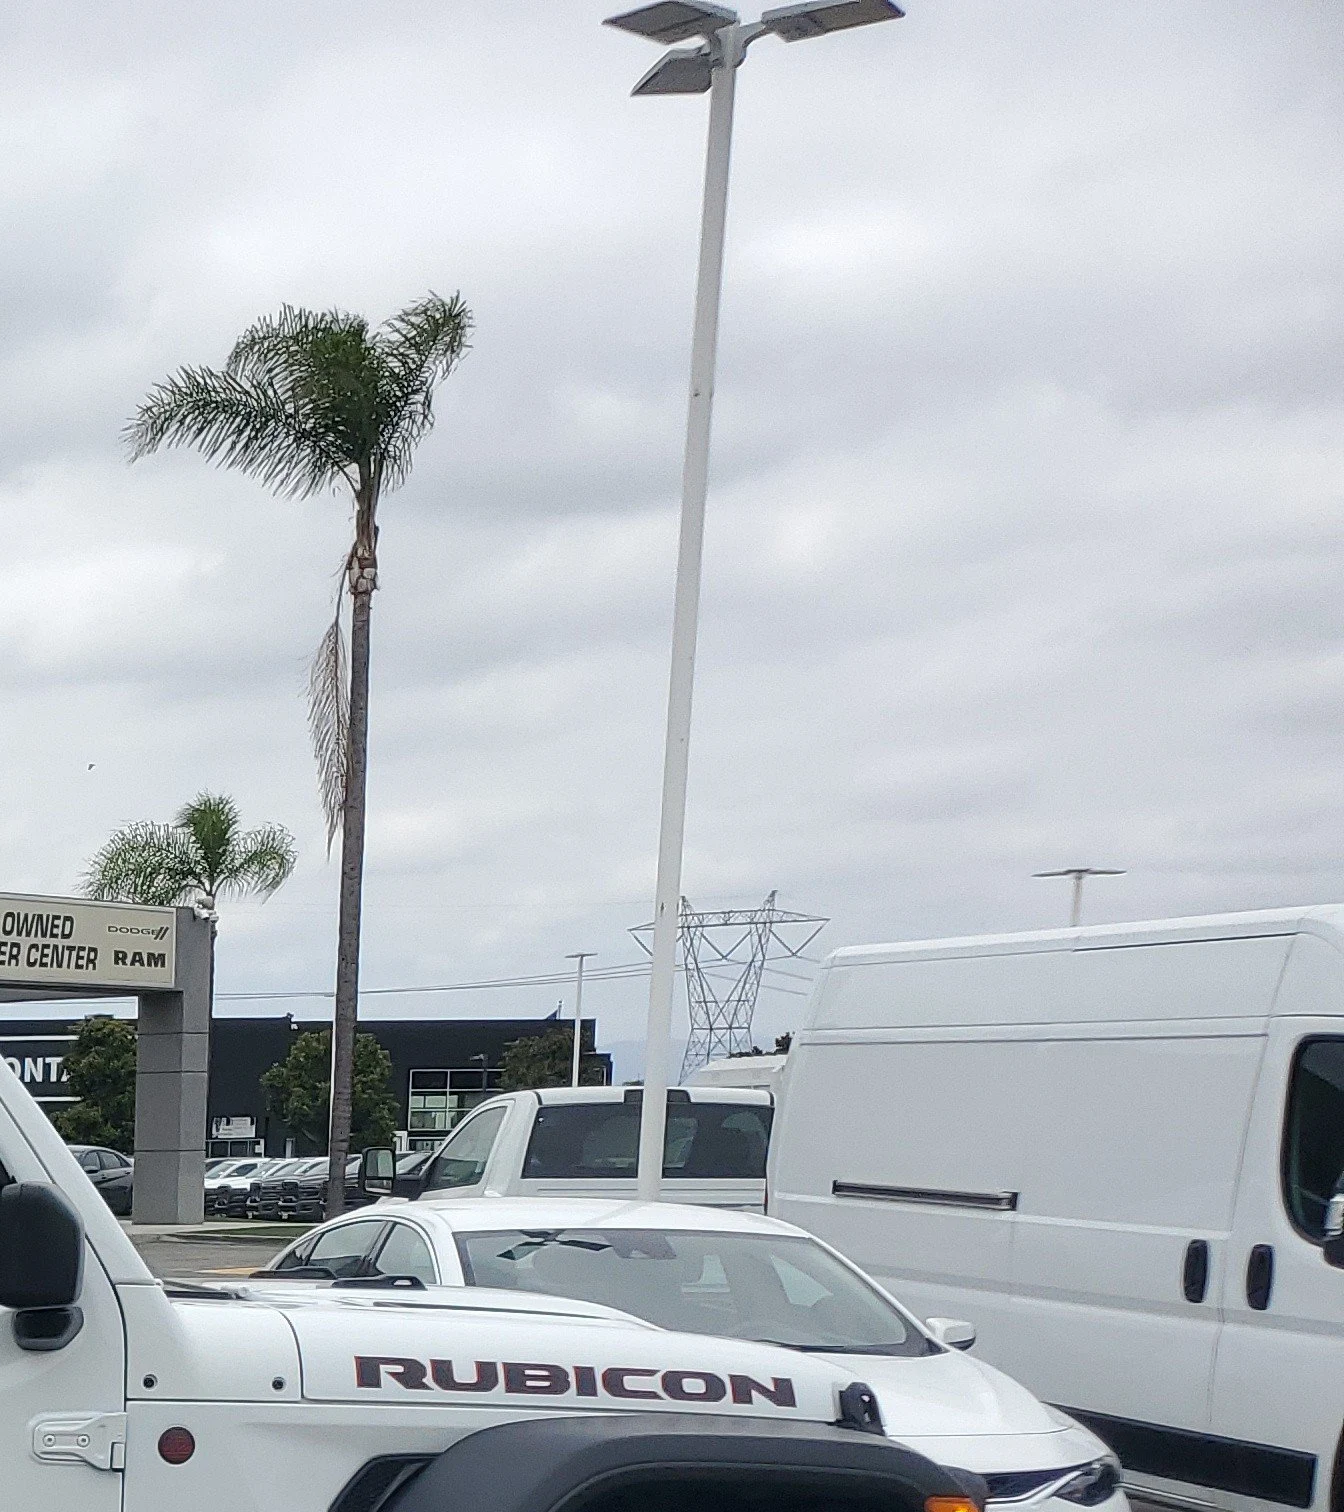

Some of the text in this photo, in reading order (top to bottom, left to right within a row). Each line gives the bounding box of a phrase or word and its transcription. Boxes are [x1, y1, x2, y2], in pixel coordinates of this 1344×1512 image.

[1, 910, 74, 940] OWNED
[107, 925, 157, 936] DODGE
[25, 943, 98, 971] CENTER
[113, 949, 166, 969] RAM
[354, 1355, 798, 1408] RUBICON
